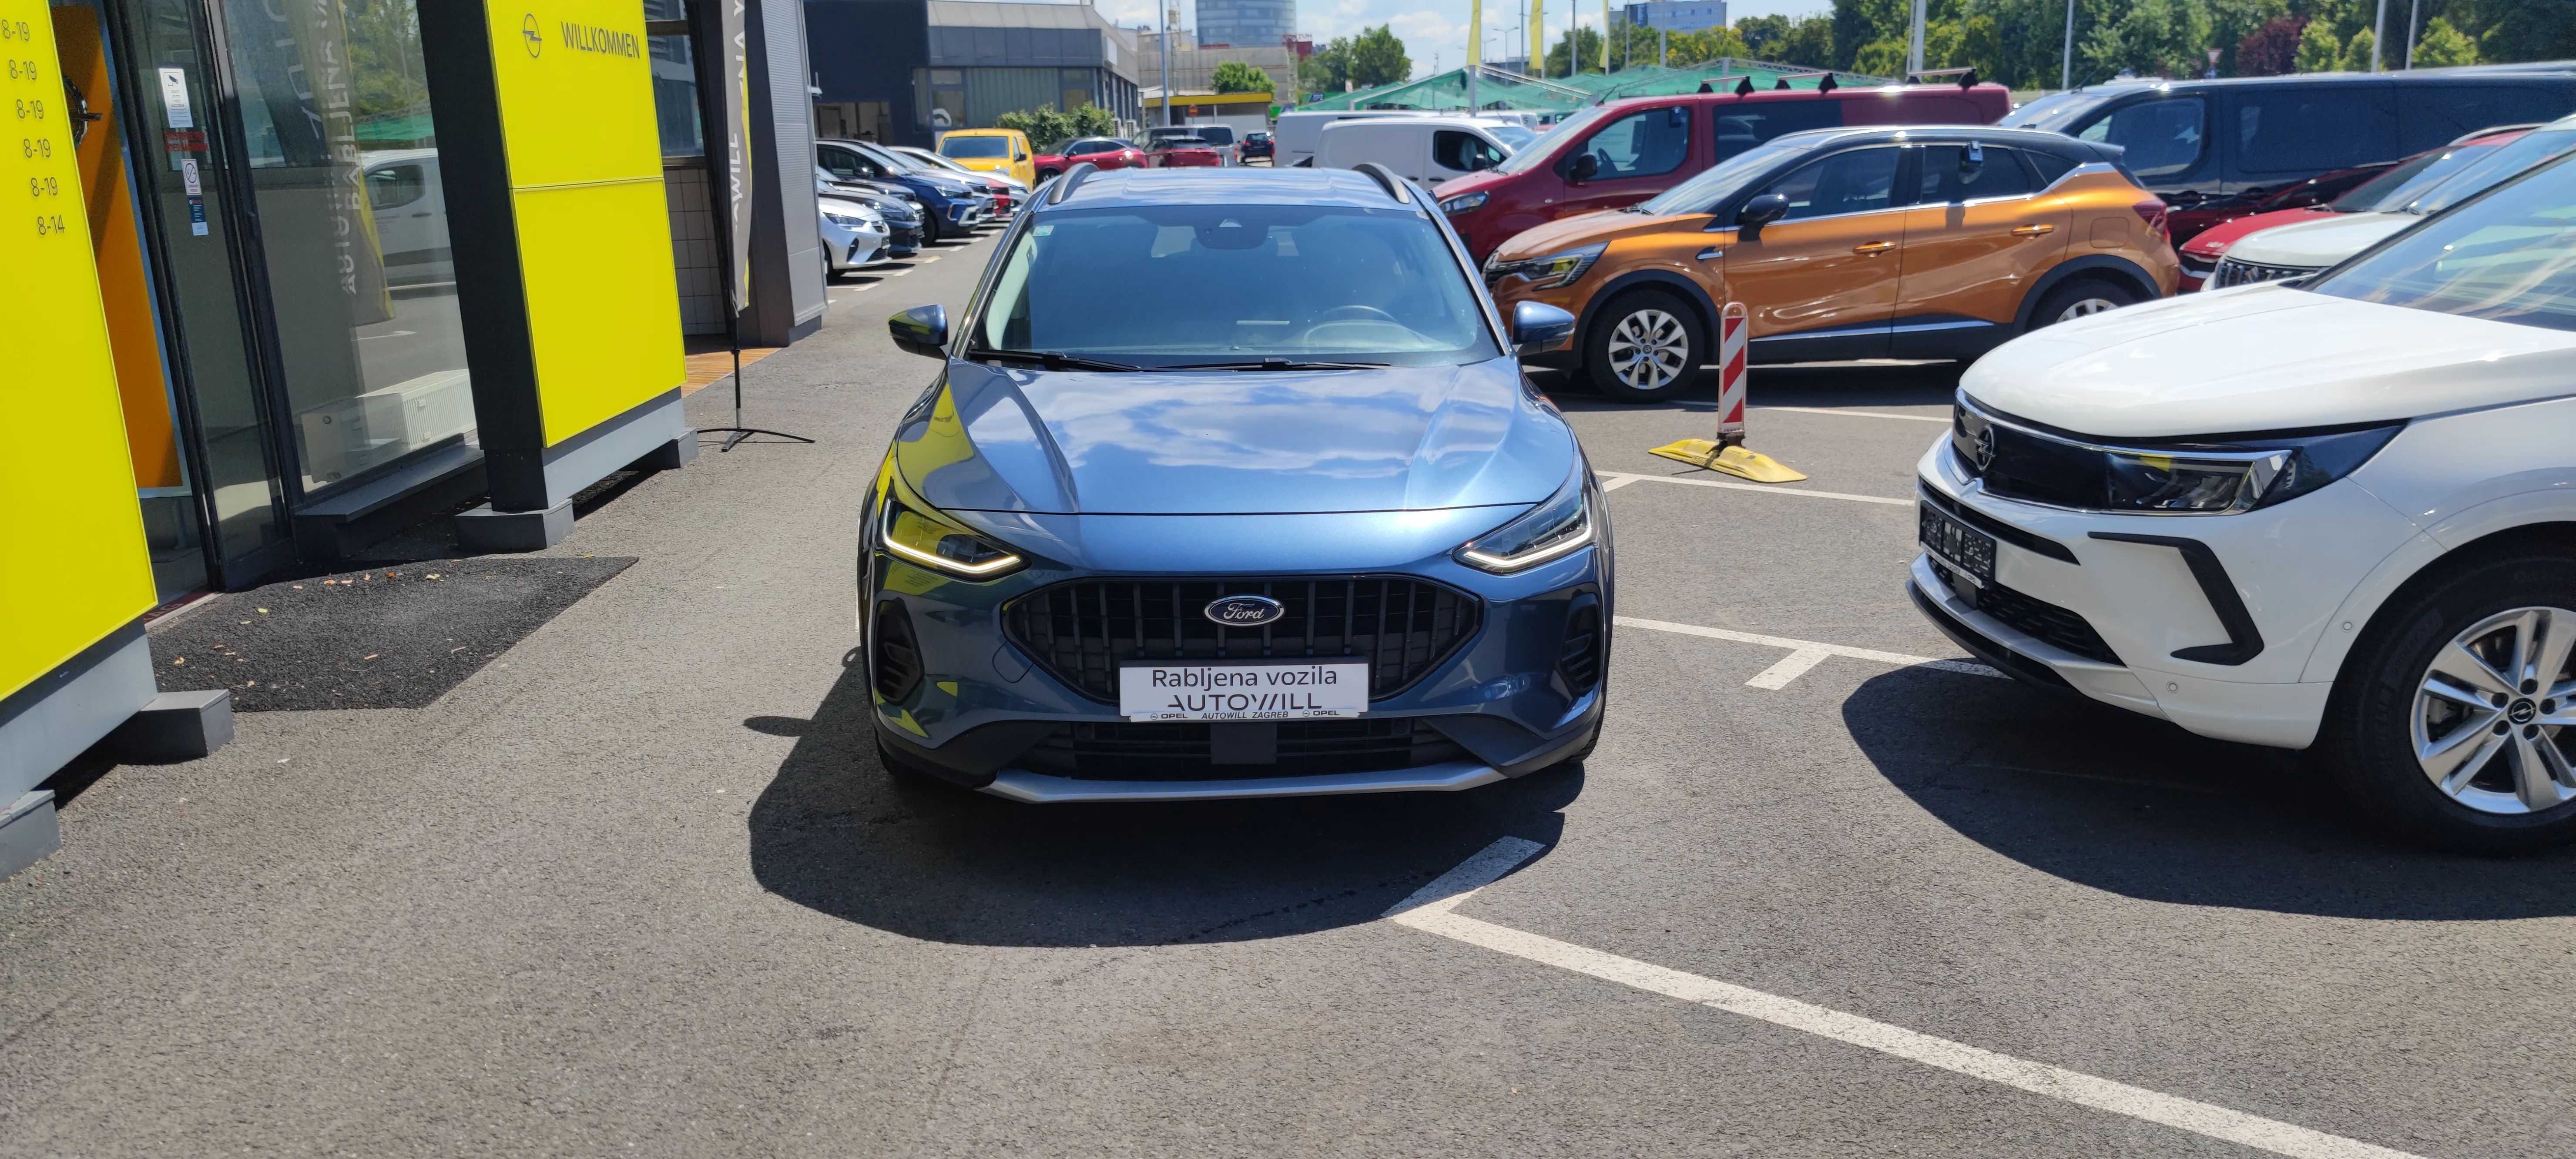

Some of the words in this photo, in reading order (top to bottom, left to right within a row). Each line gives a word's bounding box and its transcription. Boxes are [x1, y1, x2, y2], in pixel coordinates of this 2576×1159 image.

[2, 19, 30, 42] 8-19
[561, 21, 640, 59] WILLKOMMEN
[9, 59, 37, 80] 8-19
[17, 99, 44, 119] 8-19
[23, 138, 51, 158] 8-19
[31, 177, 58, 197] 8-19
[37, 215, 65, 235] 8-14
[1223, 603, 1265, 619] Ford
[1152, 667, 1258, 691] Rabljena
[1266, 666, 1337, 686] vozila
[1167, 693, 1322, 711] AUTOWILL
